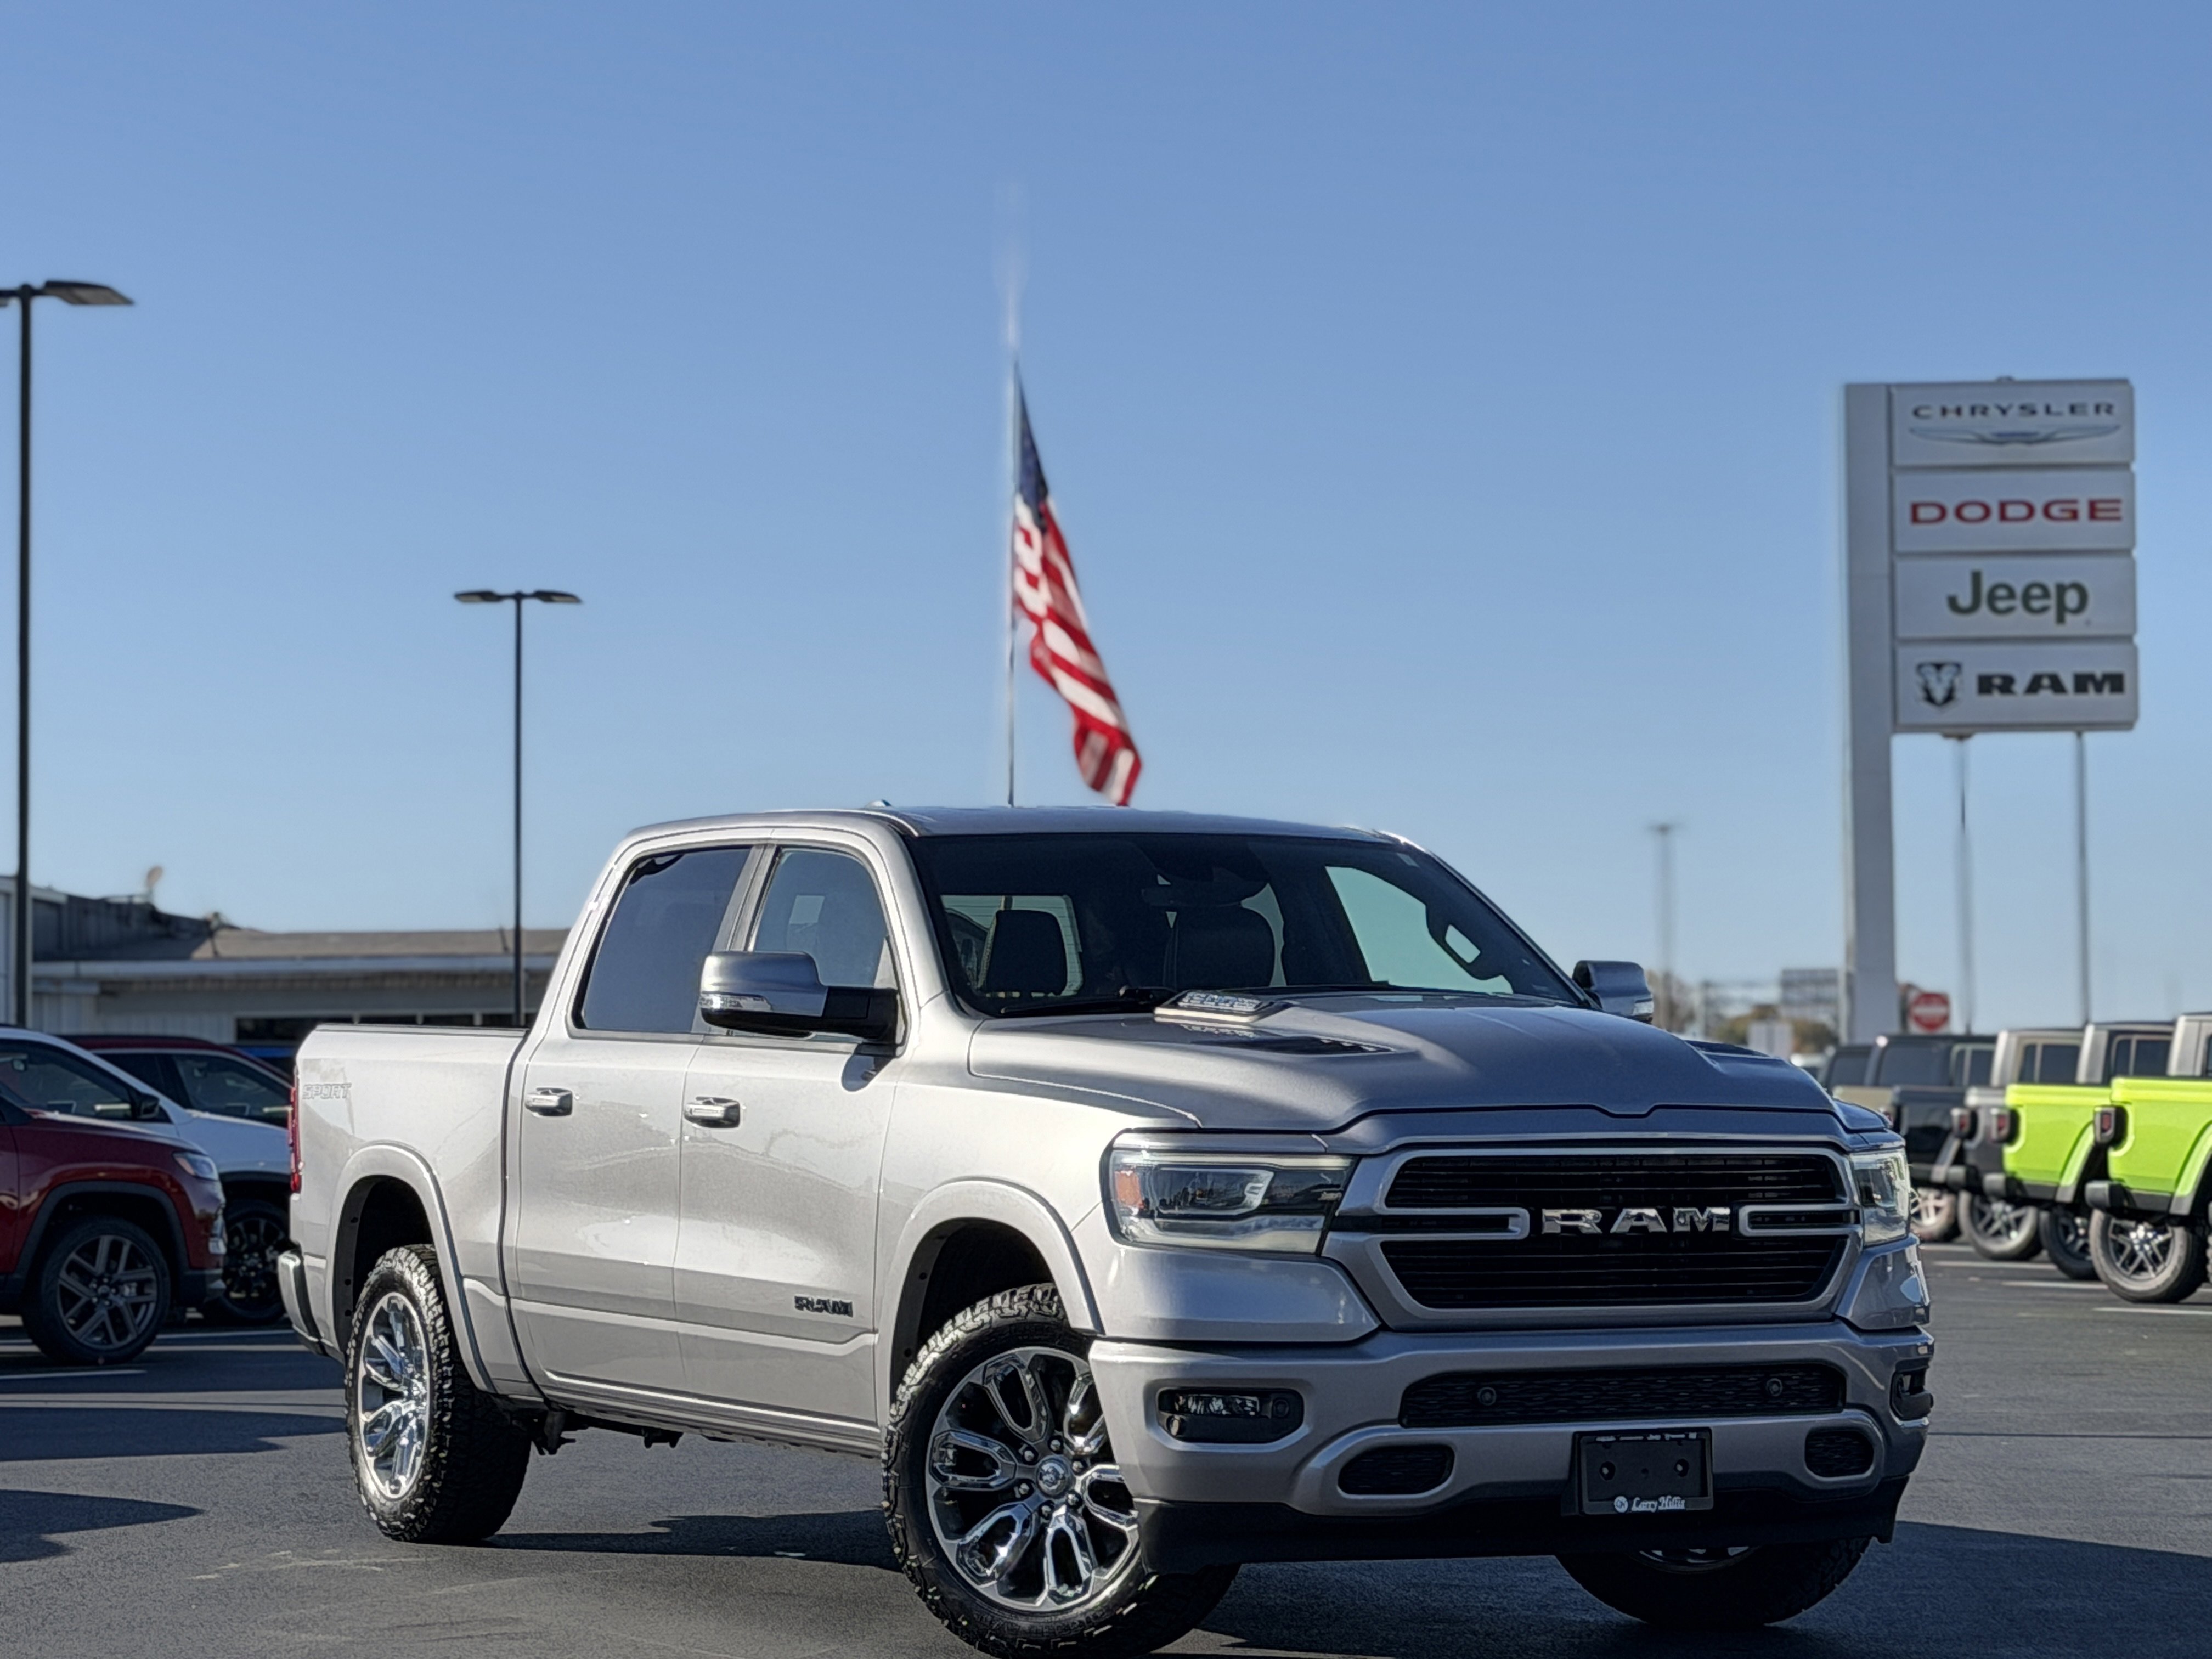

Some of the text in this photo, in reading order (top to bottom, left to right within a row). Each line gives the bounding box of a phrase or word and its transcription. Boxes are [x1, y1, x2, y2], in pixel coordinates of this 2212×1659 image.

[1911, 402, 2115, 420] CHRYSLER
[1909, 499, 2123, 525] DODGE
[1946, 569, 2089, 625] Jeep
[1977, 672, 2126, 696] RAM
[302, 1083, 352, 1099] SPORT
[1542, 1207, 1731, 1234] RAM
[794, 1295, 854, 1318] RAM
